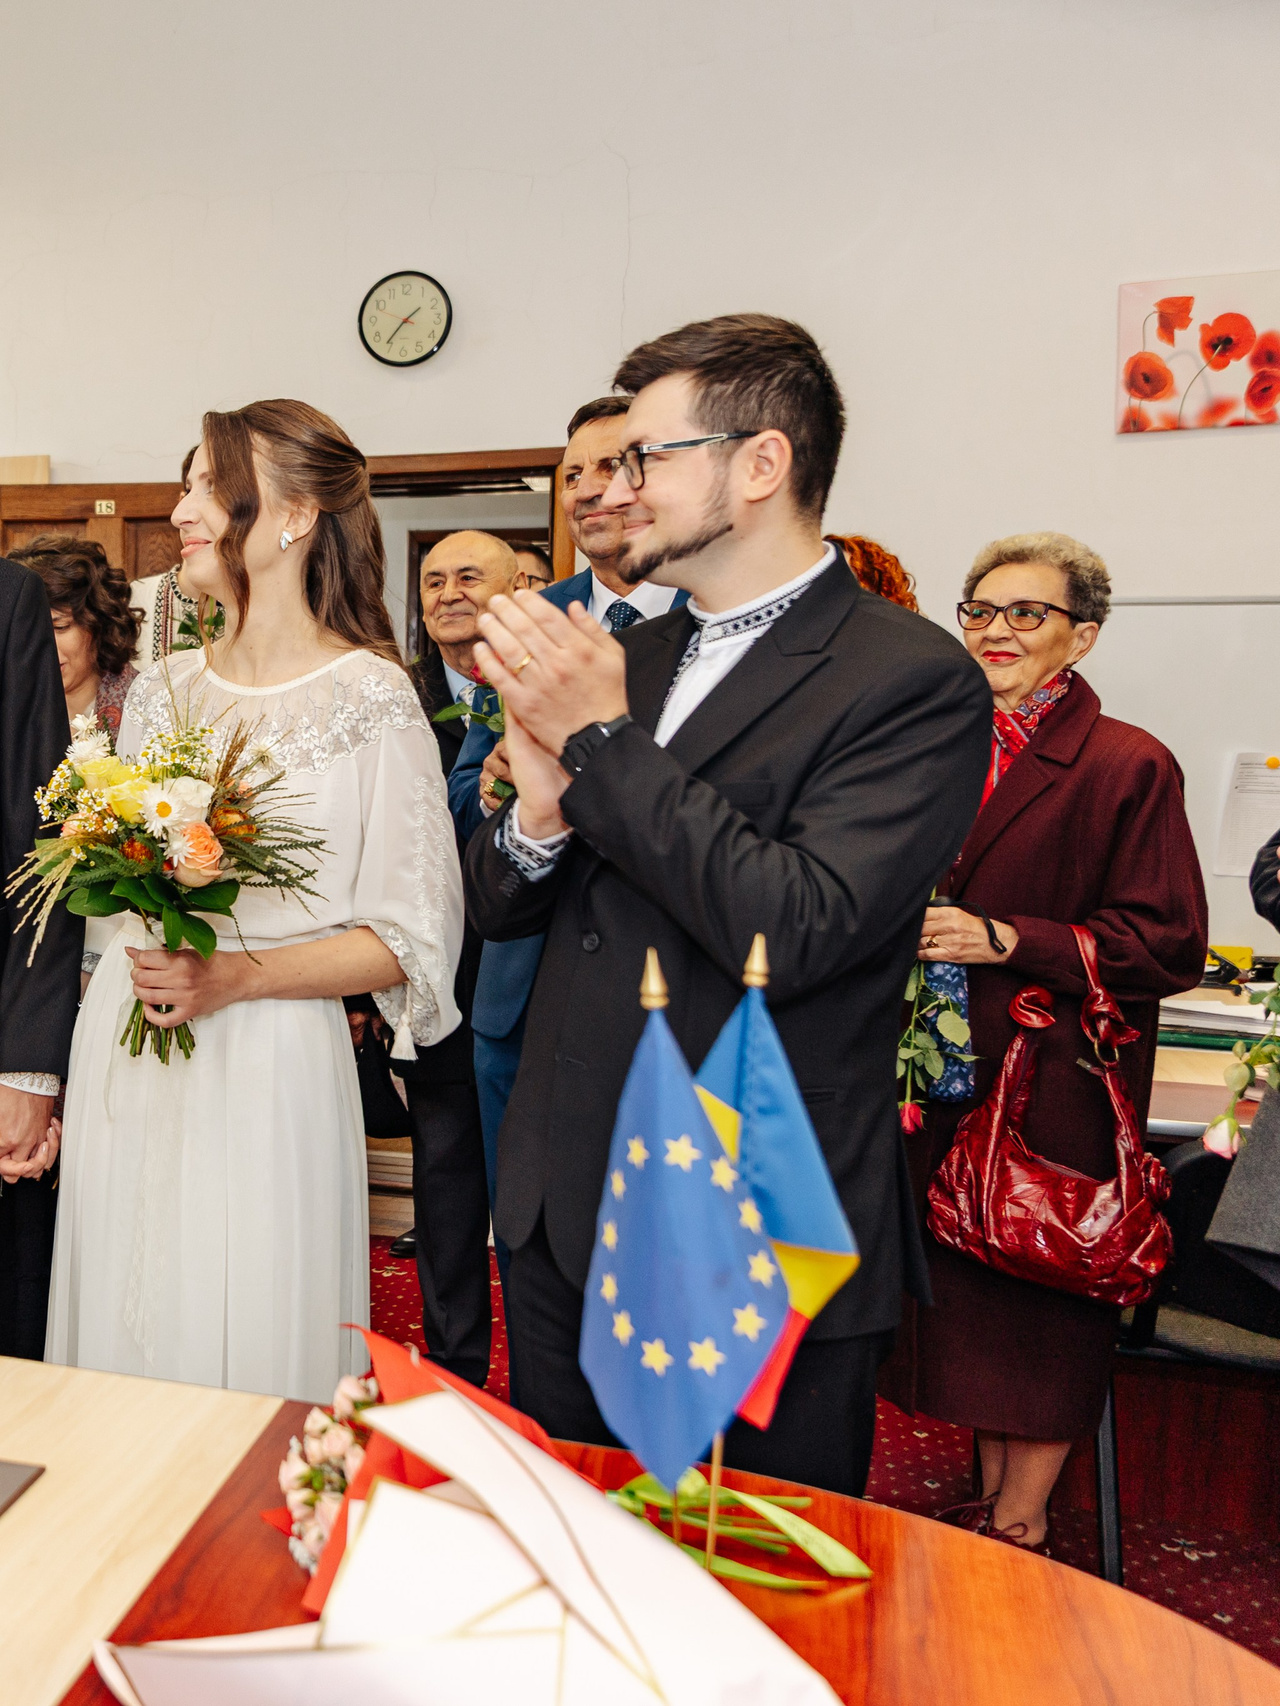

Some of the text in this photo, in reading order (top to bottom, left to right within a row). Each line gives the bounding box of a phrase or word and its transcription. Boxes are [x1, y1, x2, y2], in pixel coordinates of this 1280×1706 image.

[388, 288, 395, 300] 11
[401, 284, 412, 296] 12
[375, 299, 386, 311] 10
[430, 298, 438, 310] 2
[369, 315, 377, 327] 9
[433, 313, 442, 325] 3
[373, 331, 381, 343] 8
[428, 329, 435, 341] 4
[386, 341, 394, 353] 7
[399, 345, 407, 357] 6
[415, 341, 423, 353] 5
[98, 502, 113, 513] 18
